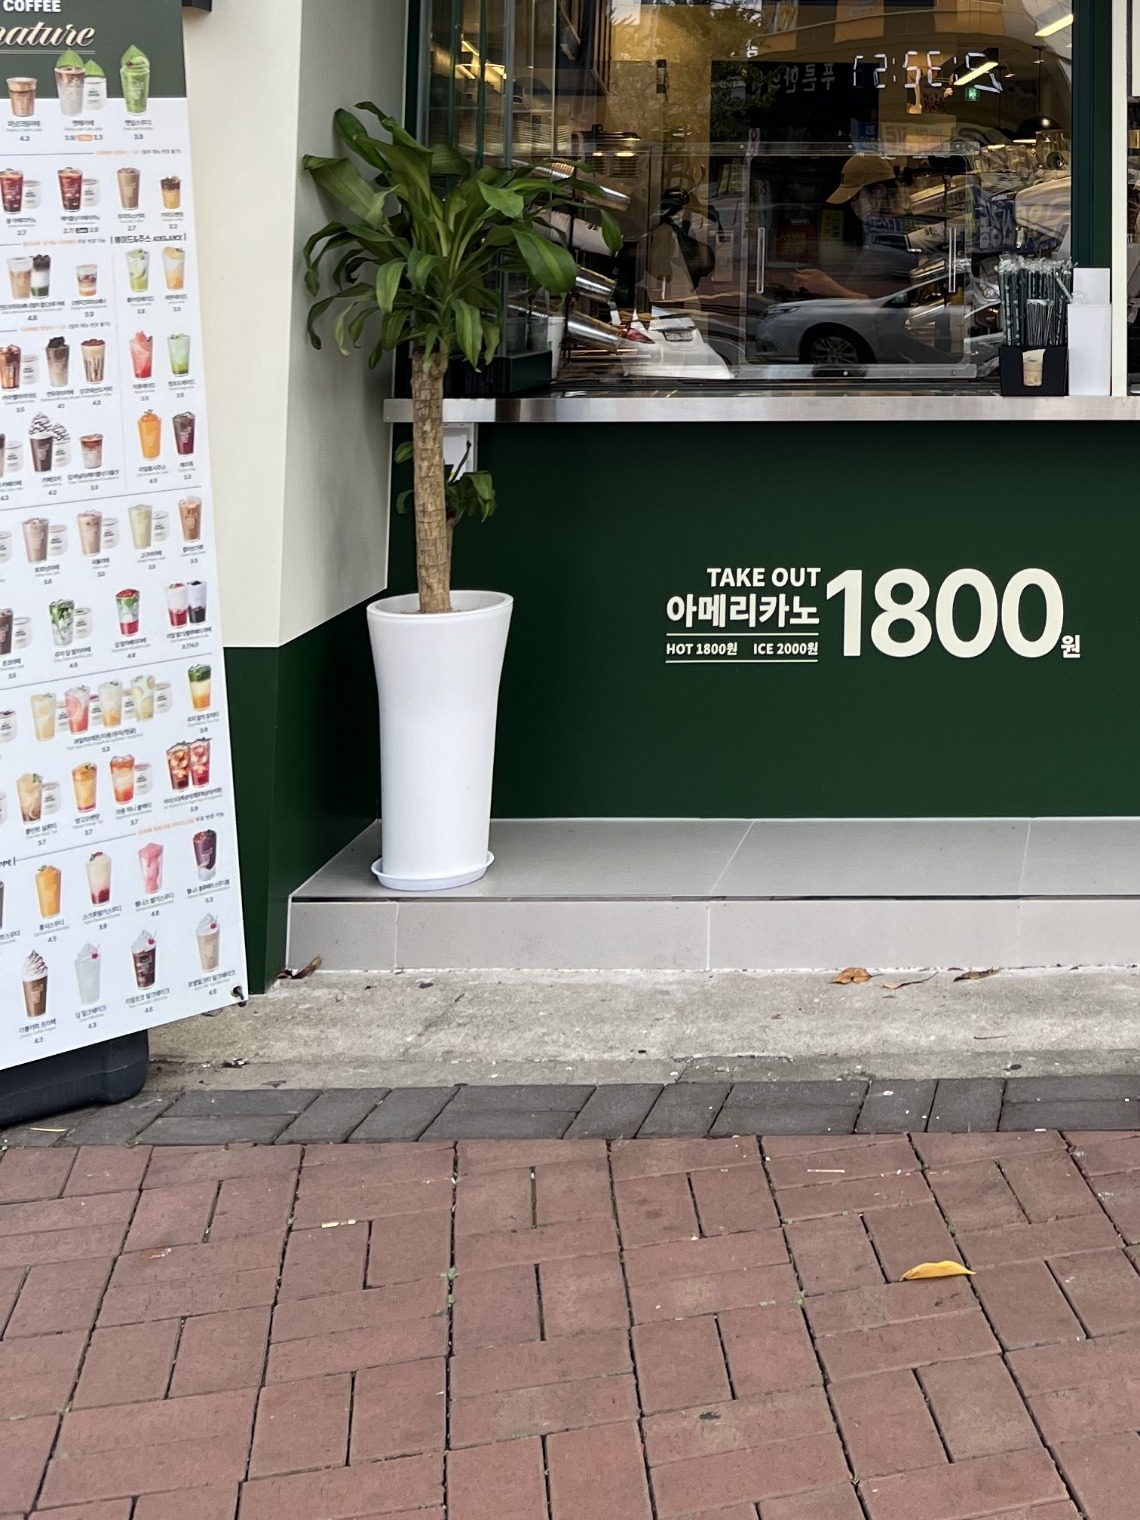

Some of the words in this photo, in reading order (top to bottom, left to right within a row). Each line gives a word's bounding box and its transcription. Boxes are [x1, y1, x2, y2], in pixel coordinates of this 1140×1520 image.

[707, 567, 765, 588] TAKE
[771, 567, 822, 587] OUT
[666, 593, 821, 628] 아메리카노
[666, 643, 695, 656] HOT
[696, 642, 738, 656] 1800원
[753, 643, 775, 655] ICE
[776, 642, 819, 656] 2000원
